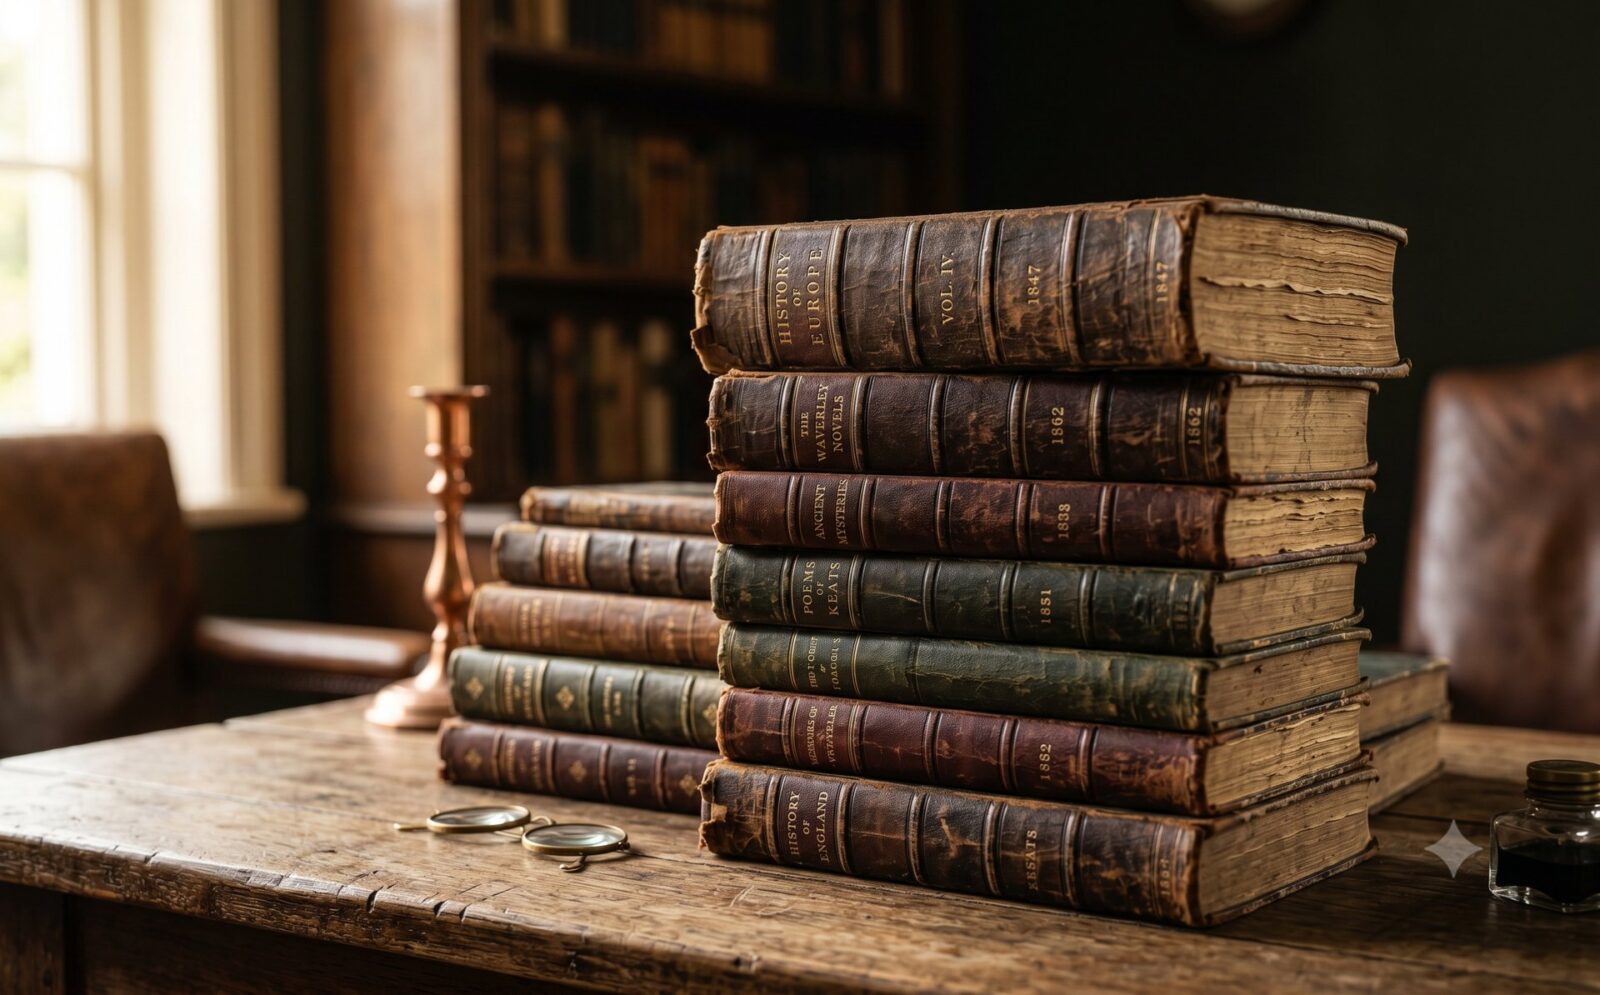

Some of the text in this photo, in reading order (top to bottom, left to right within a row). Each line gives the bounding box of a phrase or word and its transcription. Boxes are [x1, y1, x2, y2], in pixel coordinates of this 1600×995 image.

[775, 250, 792, 345] HISTORY
[792, 288, 801, 307] OF
[807, 248, 825, 346] EUROPE
[940, 251, 955, 325] VOL. IV.
[1027, 264, 1041, 305] 1847
[1156, 261, 1169, 302] 1847
[800, 411, 809, 438] THE
[815, 383, 829, 462] WAVERLEY
[832, 395, 844, 453] NOVELS
[1051, 406, 1065, 445] 1862
[1188, 407, 1202, 445] 1862
[813, 484, 827, 541] ANCIENT
[835, 478, 849, 546] MYSTERIES
[1057, 502, 1071, 540] 1838
[803, 561, 816, 615] POEMS
[816, 580, 824, 596] OF
[828, 562, 841, 616] KEATS
[1039, 743, 1052, 781] 1882
[785, 790, 801, 856] HISTORY
[802, 819, 811, 836] OF
[815, 790, 829, 864] ENGLAND
